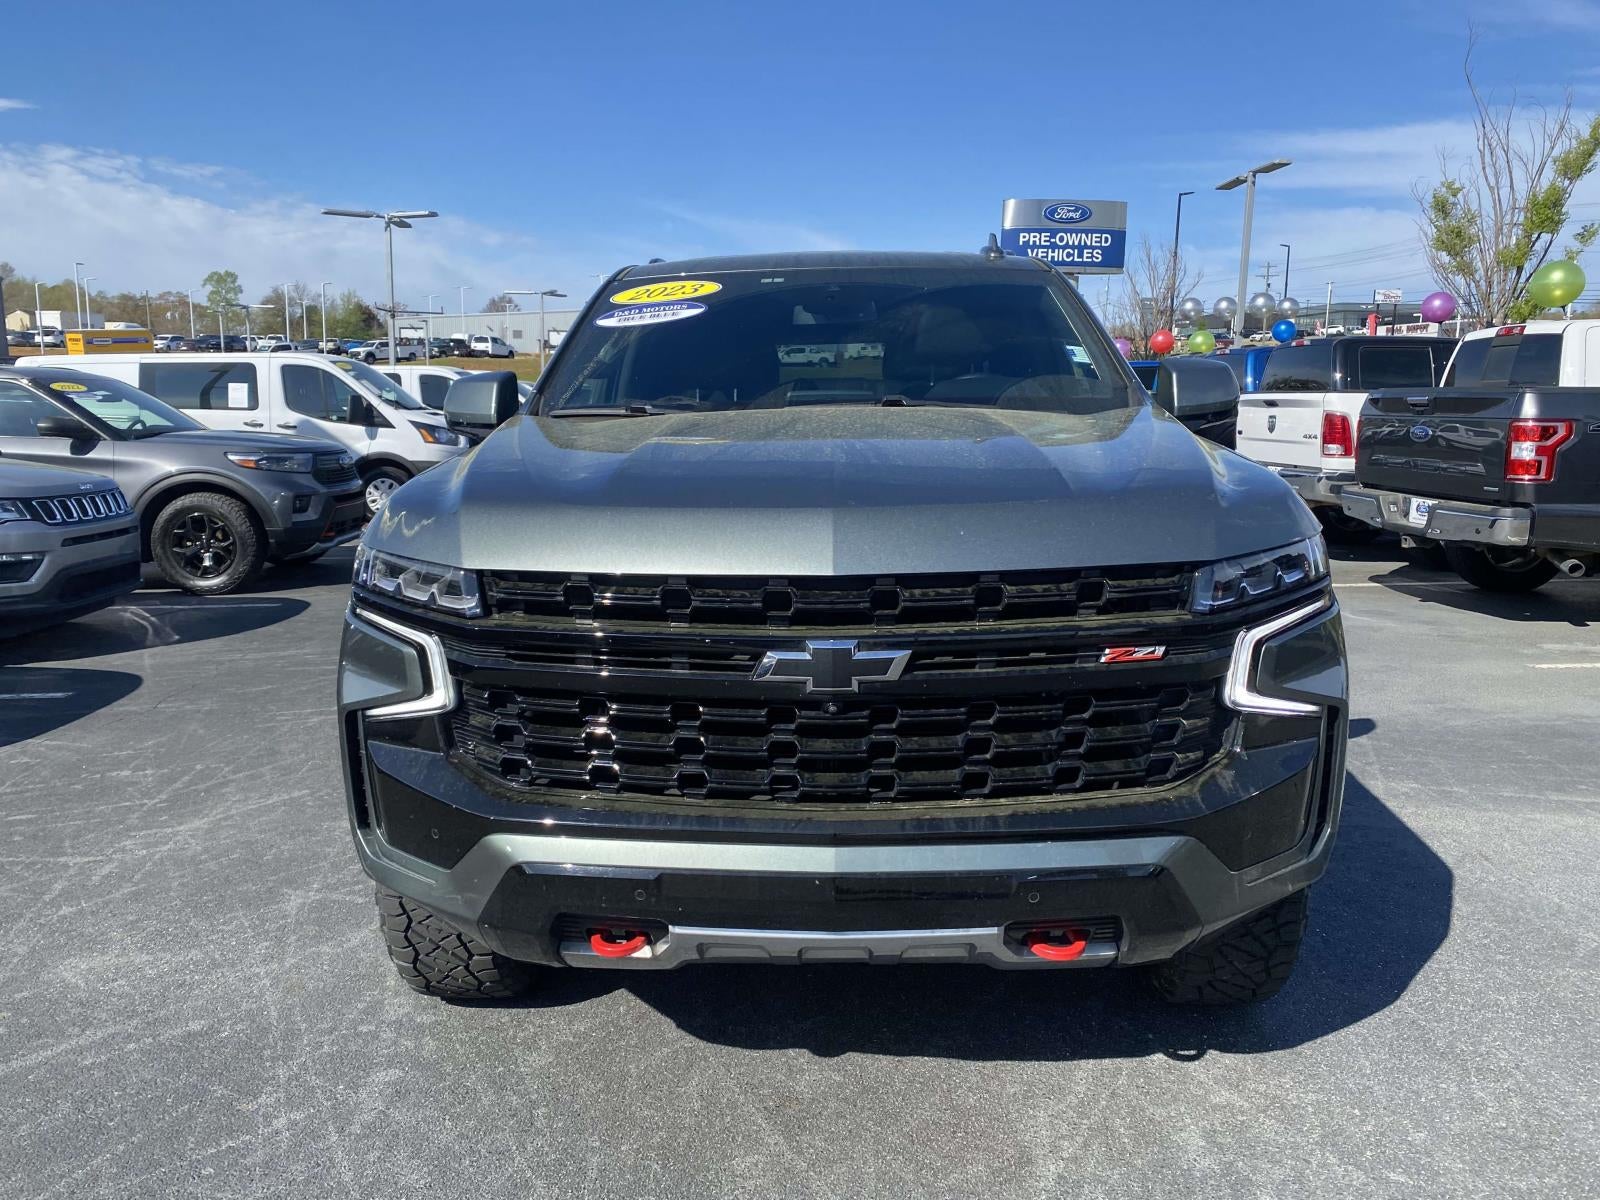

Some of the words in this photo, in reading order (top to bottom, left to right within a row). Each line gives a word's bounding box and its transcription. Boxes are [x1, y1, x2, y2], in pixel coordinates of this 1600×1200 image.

[1054, 206, 1082, 219] Ford
[1019, 232, 1112, 246] PRE-OWNED
[1027, 248, 1102, 262] VEHICLES
[627, 283, 705, 301] 2023
[614, 309, 640, 317] D&D
[641, 304, 689, 313] MOTORS
[1100, 645, 1167, 662] Z71
